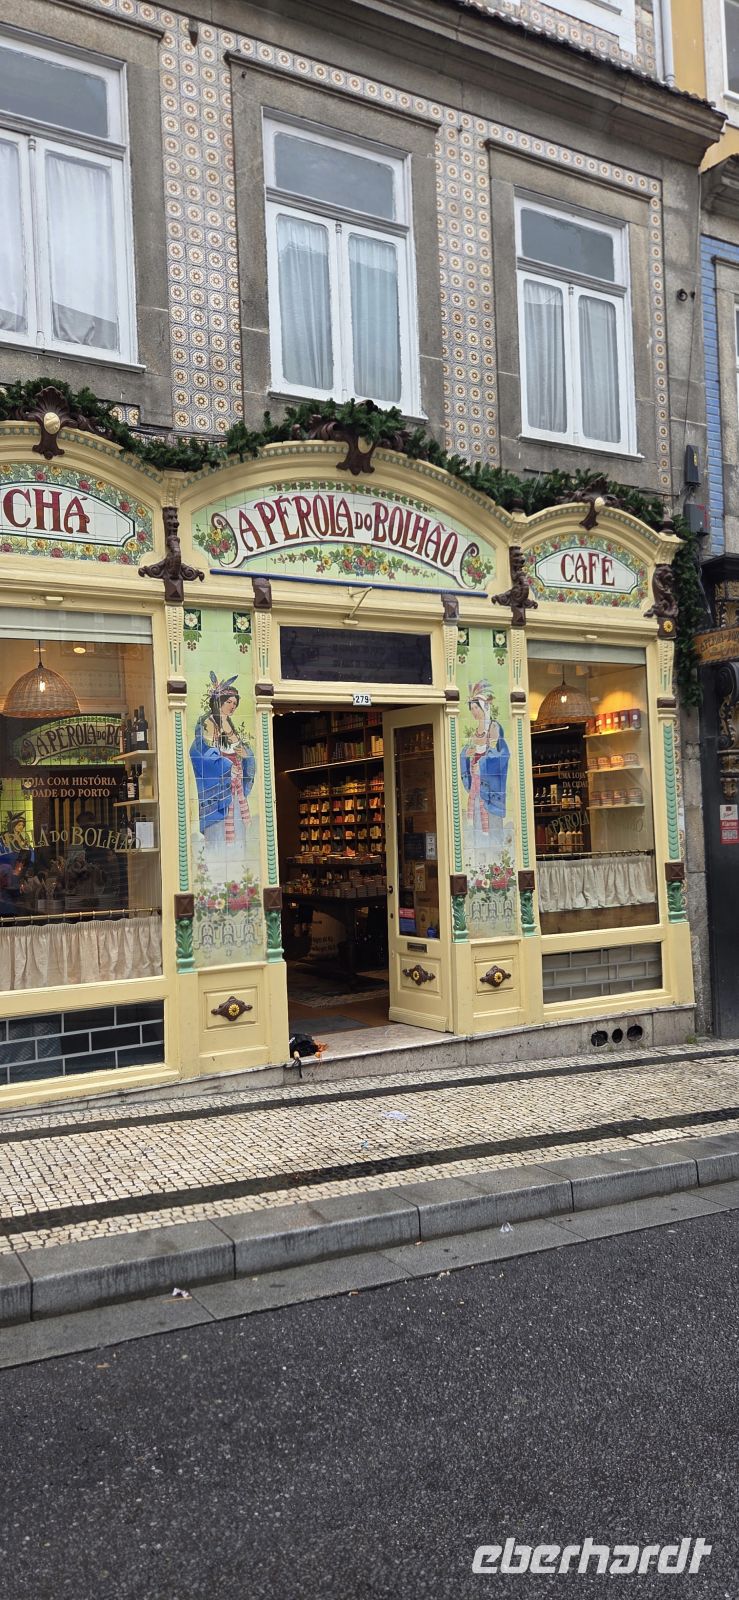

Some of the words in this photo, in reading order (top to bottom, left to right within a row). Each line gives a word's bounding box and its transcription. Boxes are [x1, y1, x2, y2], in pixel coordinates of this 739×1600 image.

[3, 488, 90, 534] CHÁ
[239, 509, 261, 551] A
[254, 494, 356, 547] PÉROLA
[354, 511, 373, 532] DO
[371, 501, 459, 568] BOLHÃO
[560, 552, 615, 587] CAFÉ
[355, 695, 369, 704] 279
[48, 776, 70, 786] COM
[72, 774, 117, 786] HISTÓRIA
[60, 788, 75, 798] DO
[78, 788, 110, 798] PORTO
[50, 830, 69, 843] DO
